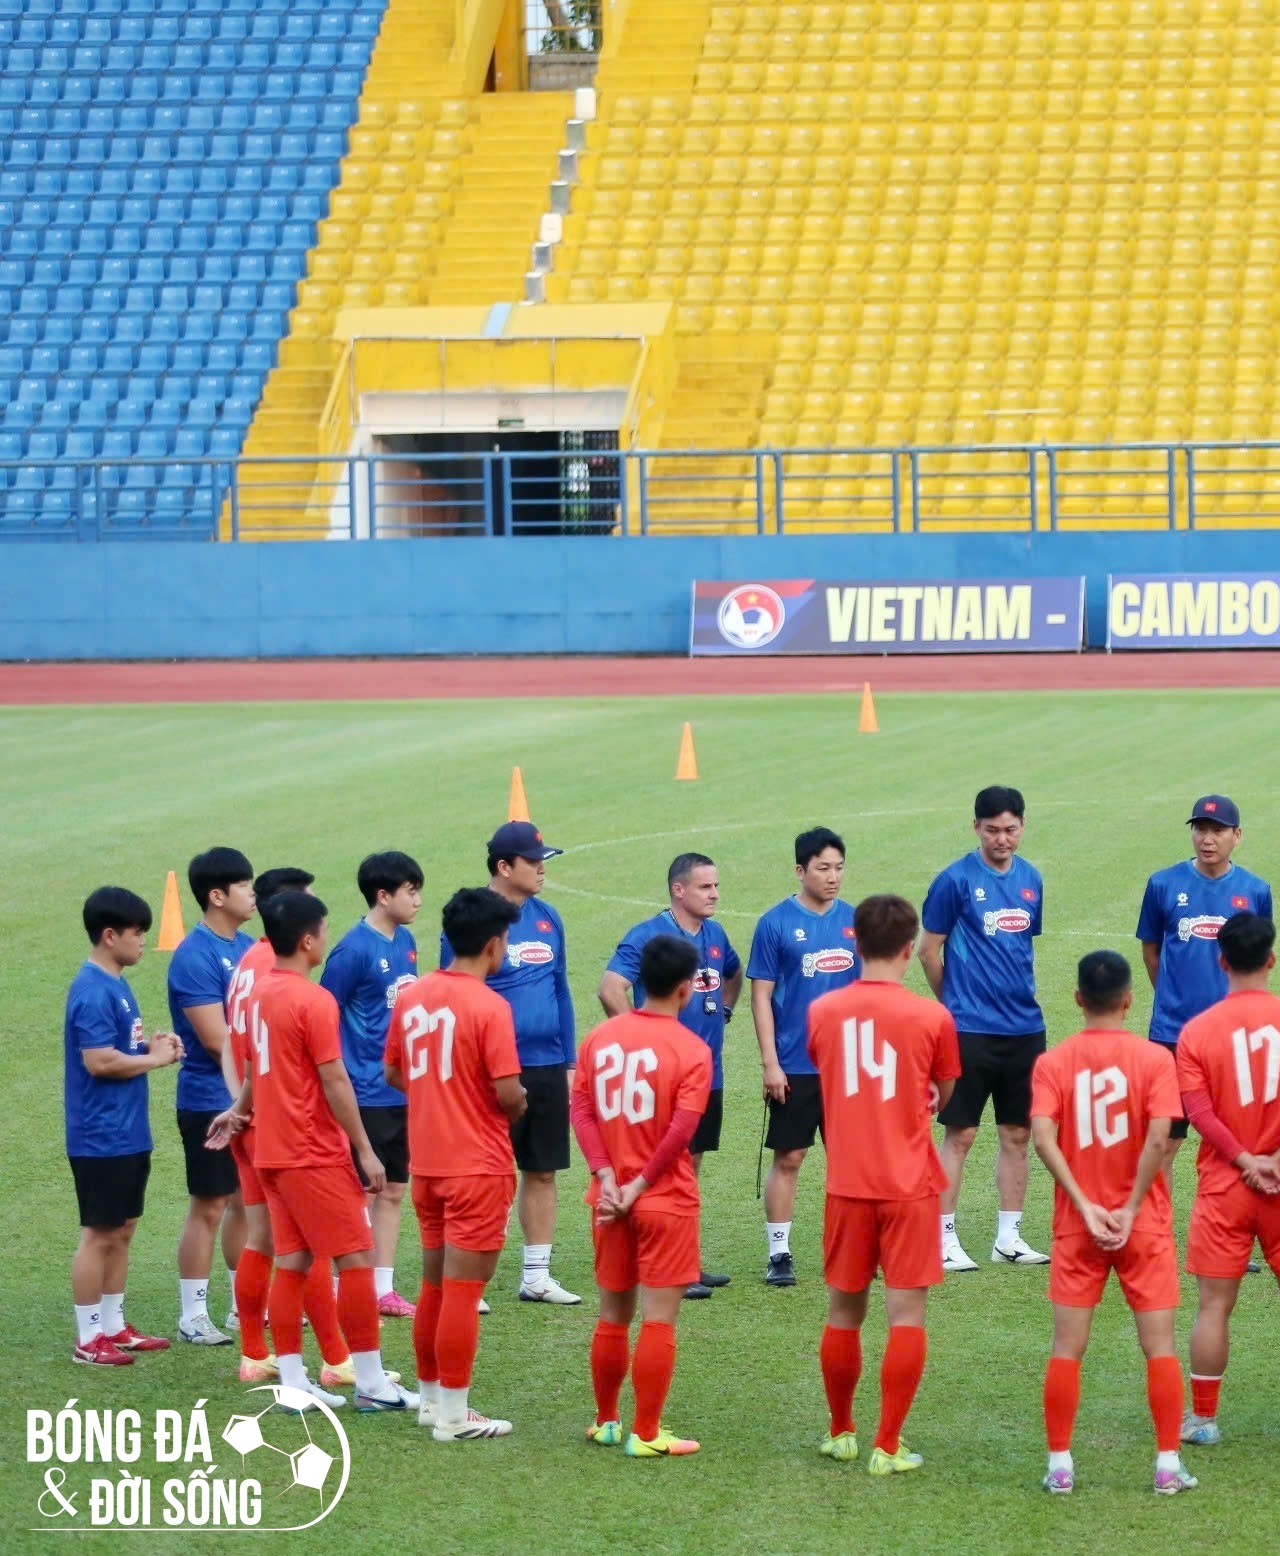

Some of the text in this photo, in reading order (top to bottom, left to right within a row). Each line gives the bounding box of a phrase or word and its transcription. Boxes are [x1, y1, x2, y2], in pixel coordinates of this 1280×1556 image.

[826, 585, 1032, 642] VIETNAM
[253, 1000, 270, 1076] 4
[403, 1004, 456, 1083] 27
[842, 1016, 897, 1101] 14
[595, 1042, 658, 1124] 26
[1075, 1066, 1128, 1150] 12
